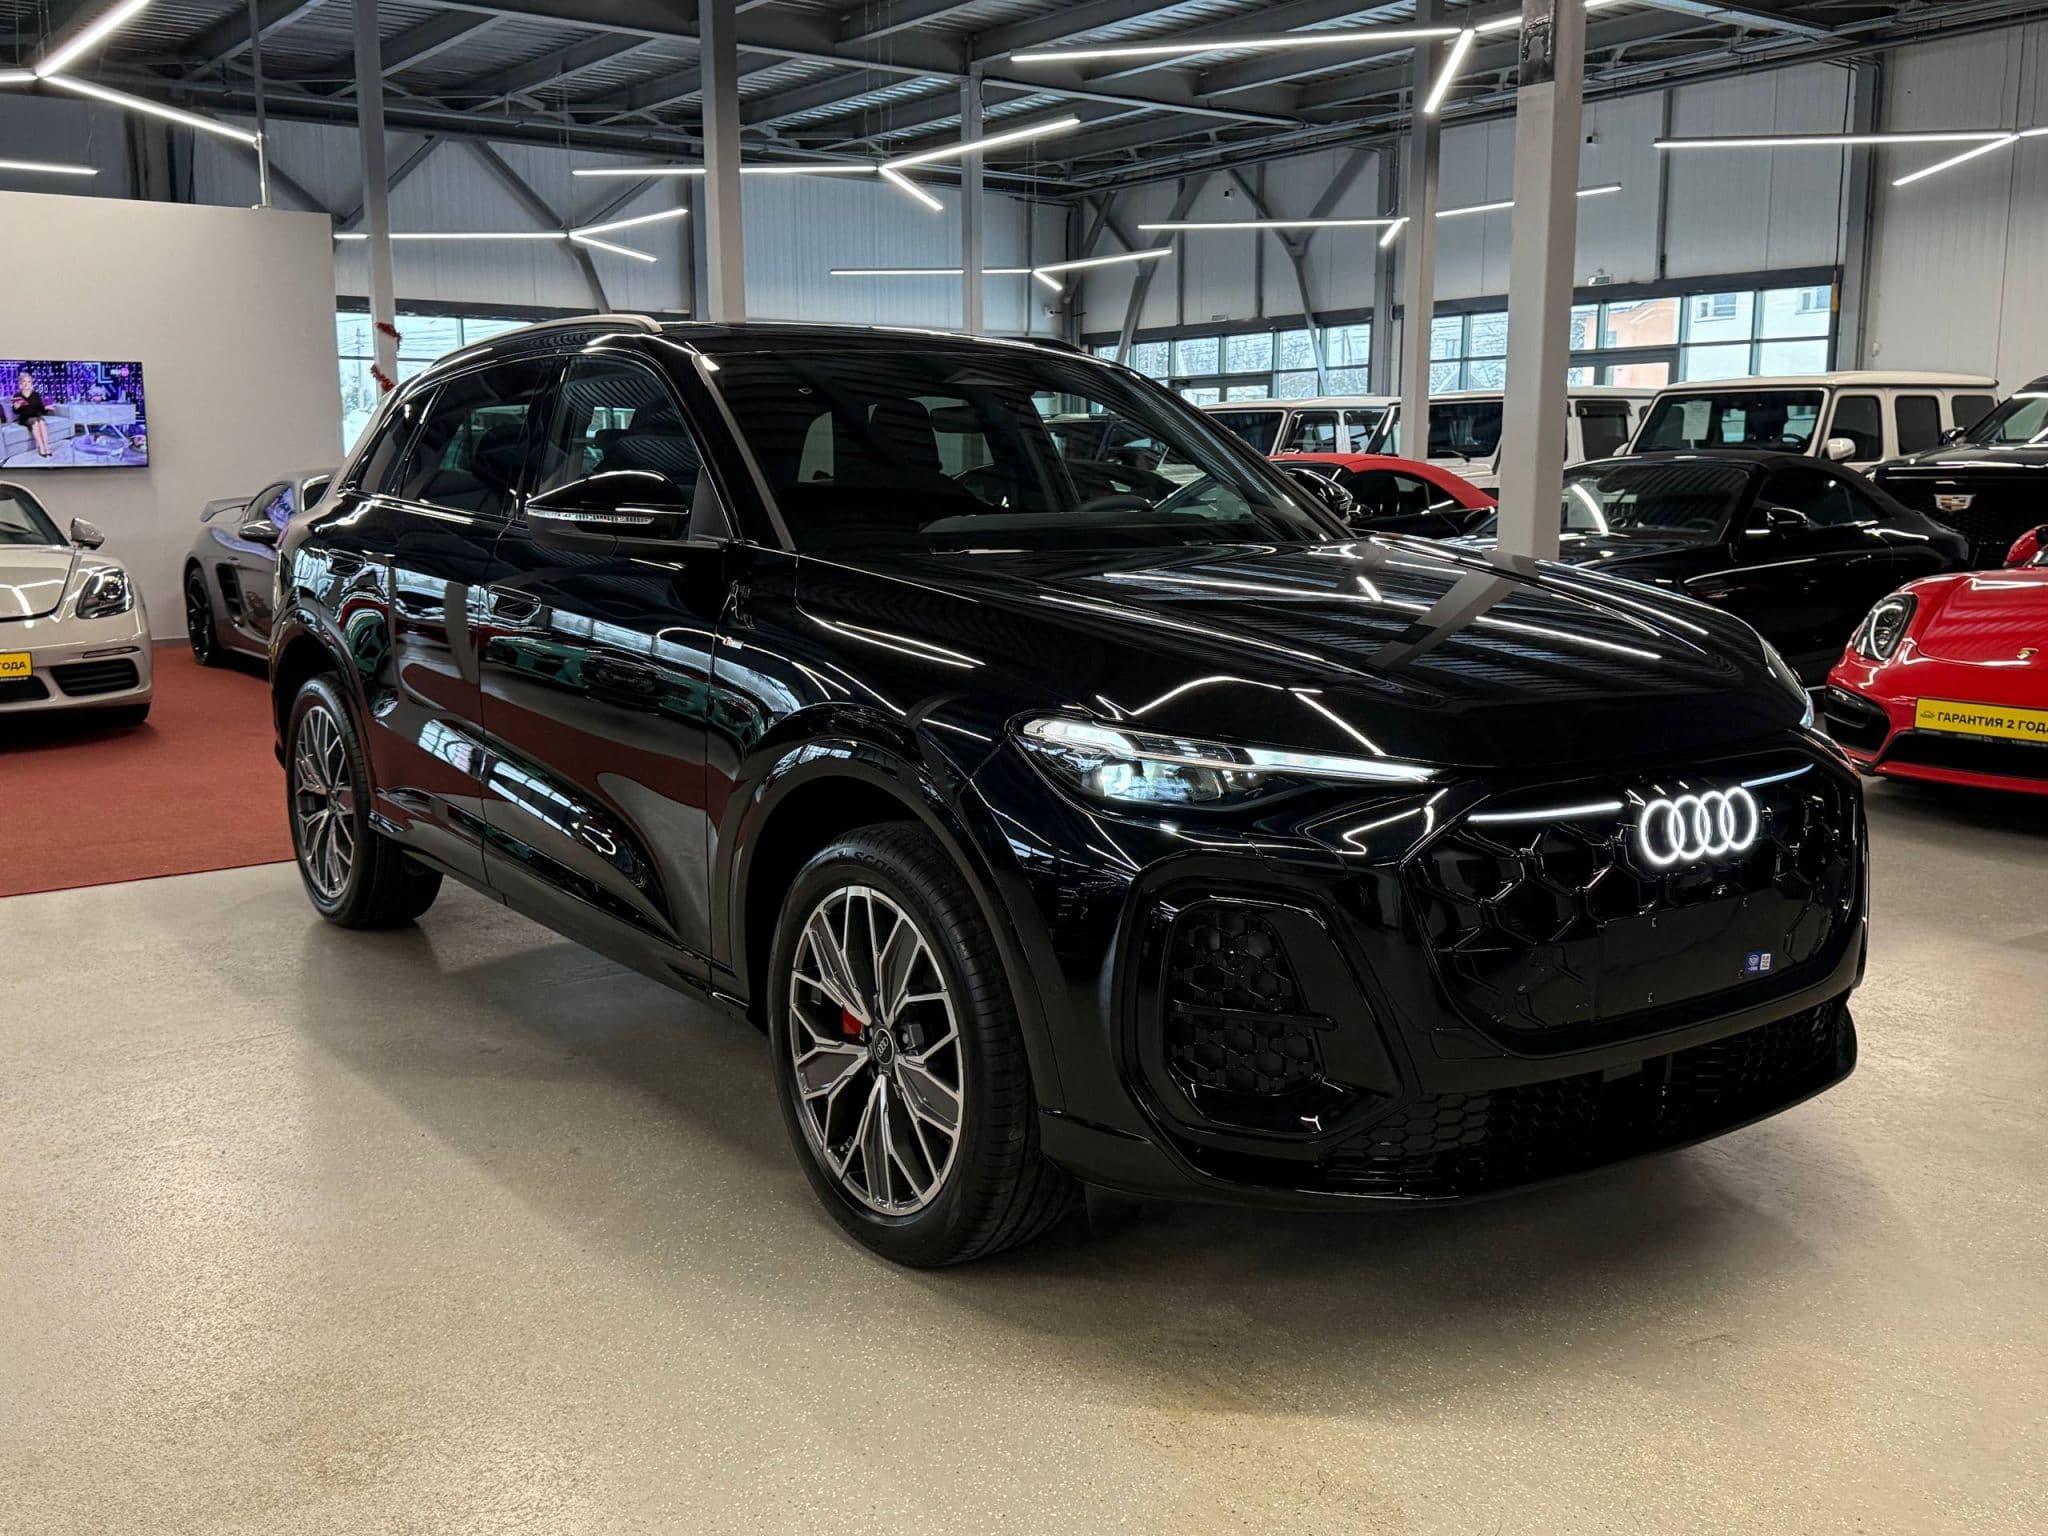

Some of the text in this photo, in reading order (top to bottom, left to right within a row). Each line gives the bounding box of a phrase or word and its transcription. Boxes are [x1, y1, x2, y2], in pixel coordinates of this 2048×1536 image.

[0, 661, 26, 671] ОДА
[1937, 711, 2048, 735] ГАРАНТИЯ 2 ГОД
